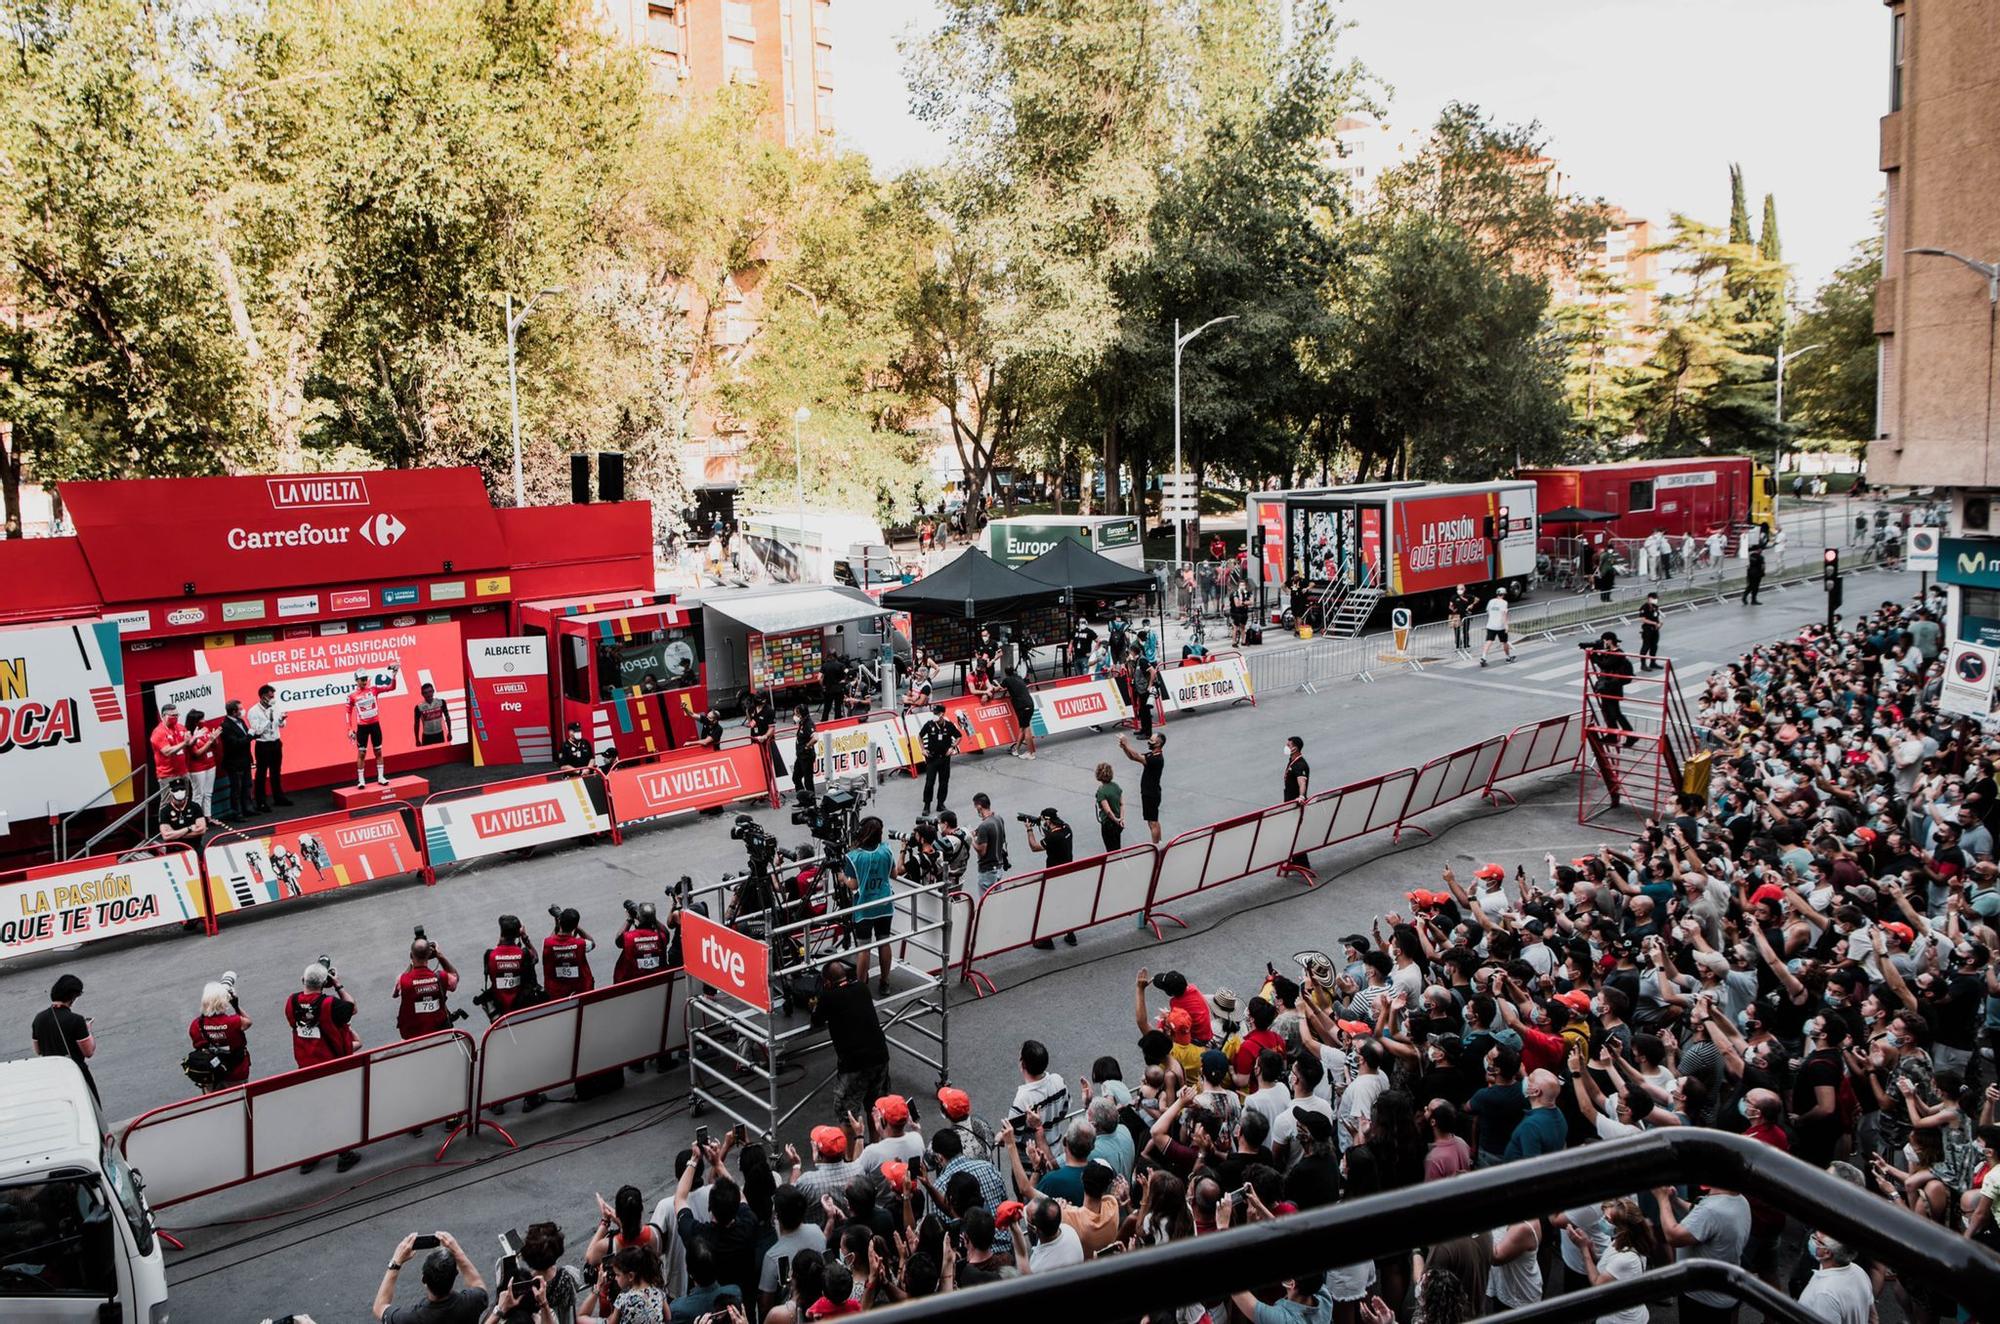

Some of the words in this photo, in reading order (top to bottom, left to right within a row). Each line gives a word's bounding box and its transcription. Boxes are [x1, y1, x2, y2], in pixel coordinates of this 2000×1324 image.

[279, 484, 299, 503] LA
[301, 481, 359, 502] VUELTA
[228, 523, 350, 550] Carrefour
[1422, 523, 1437, 545] LA
[1437, 514, 1474, 541] PASIÓN
[1410, 544, 1436, 571] QUE
[1438, 543, 1454, 567] TE
[1455, 537, 1486, 564] TOCA
[344, 595, 367, 604] Cofidis
[117, 616, 146, 624] TISSOT
[251, 648, 286, 666] LÍDER
[290, 649, 308, 661] DE
[310, 647, 326, 659] LA
[329, 635, 416, 657] CLASIFICACIÓN
[484, 645, 531, 656] ALBACETE
[274, 657, 331, 675] GENERAL
[334, 650, 401, 669] INDIVIDUAL
[169, 684, 212, 704] TARANCÓN
[504, 684, 524, 692] VUELTA
[1178, 684, 1197, 701] QUE
[1198, 683, 1211, 698] TE
[1211, 679, 1234, 694] TOCA
[501, 701, 522, 712] rtve
[979, 708, 988, 719] LA
[986, 705, 1008, 717] VUELTA
[1059, 703, 1074, 716] LA
[1071, 695, 1104, 714] VUELTA
[832, 753, 848, 770] TE
[851, 746, 884, 766] TOA
[650, 776, 673, 800] LA
[673, 764, 731, 795] VUELTA
[480, 814, 502, 836] LA
[501, 803, 558, 832] VUELTA
[343, 831, 359, 844] LA
[357, 823, 393, 842] VUELTA
[20, 892, 49, 917] LA
[53, 873, 133, 910] PASIÓN
[1, 914, 53, 945] QUE
[58, 906, 89, 934] TE
[97, 894, 157, 927] TOCA
[701, 934, 745, 987] rtve
[423, 1002, 435, 1010] 78
